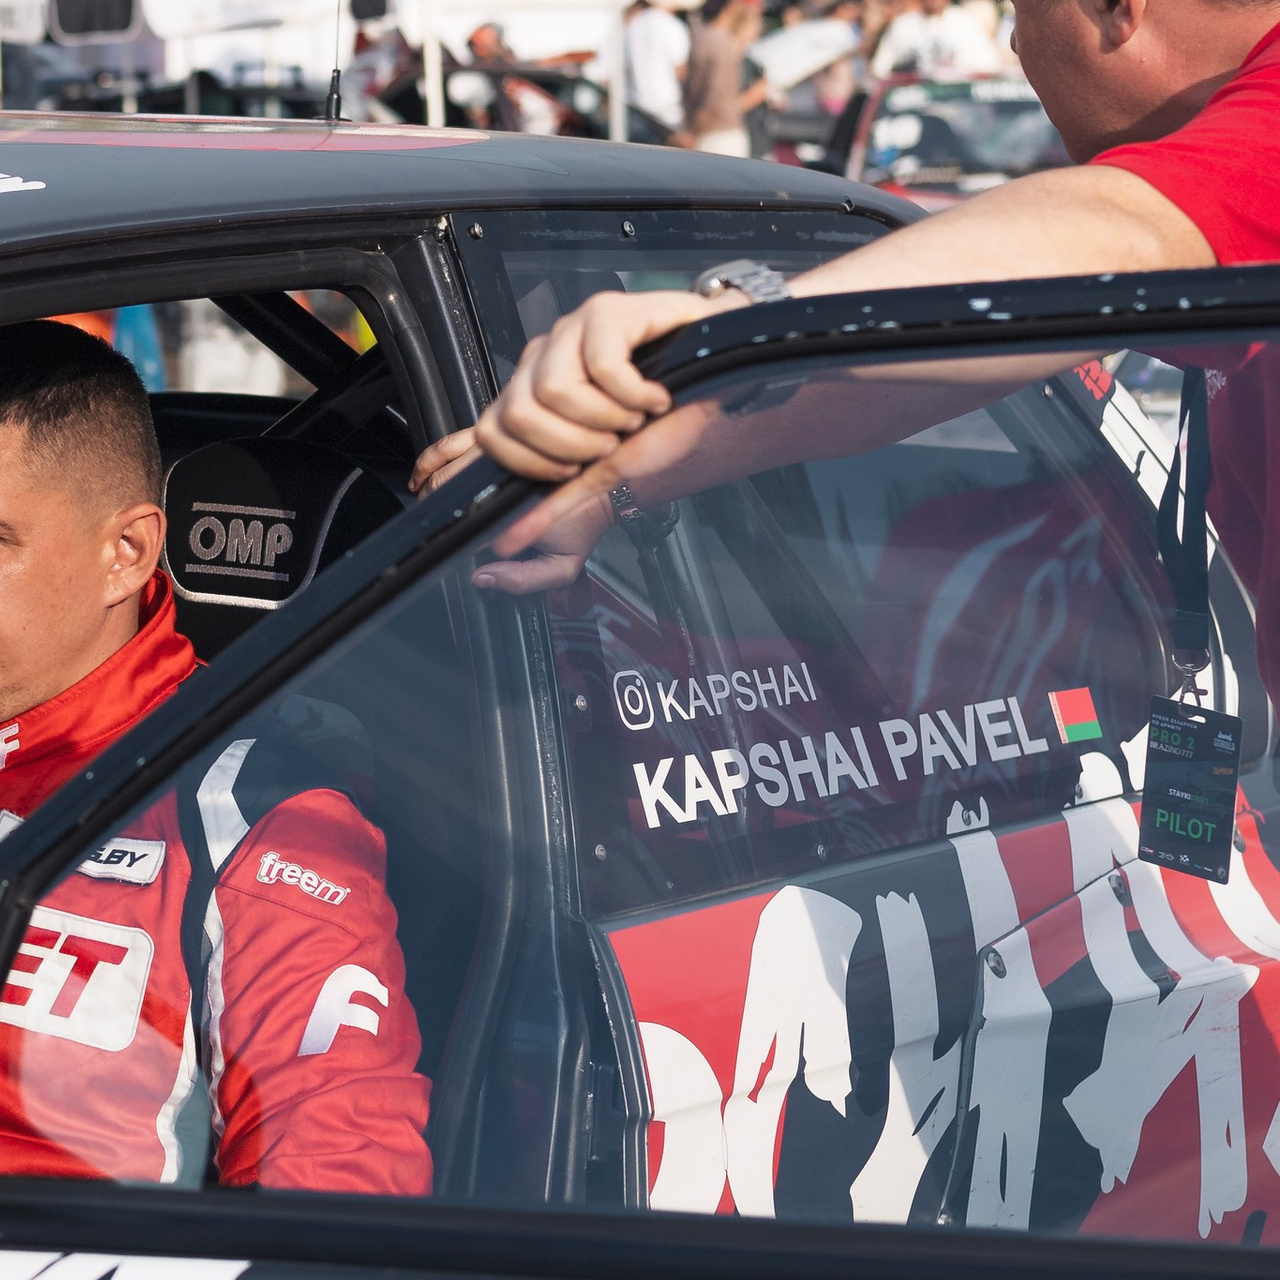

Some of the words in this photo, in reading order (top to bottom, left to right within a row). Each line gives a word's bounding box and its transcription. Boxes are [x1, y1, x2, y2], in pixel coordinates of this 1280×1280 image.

[189, 514, 294, 567] OMP
[657, 662, 818, 723] KAPSHAI
[633, 725, 879, 829] KAPSHAI
[879, 696, 1049, 782] PAVEL
[1150, 726, 1181, 746] PRO
[1155, 807, 1217, 843] PILOT
